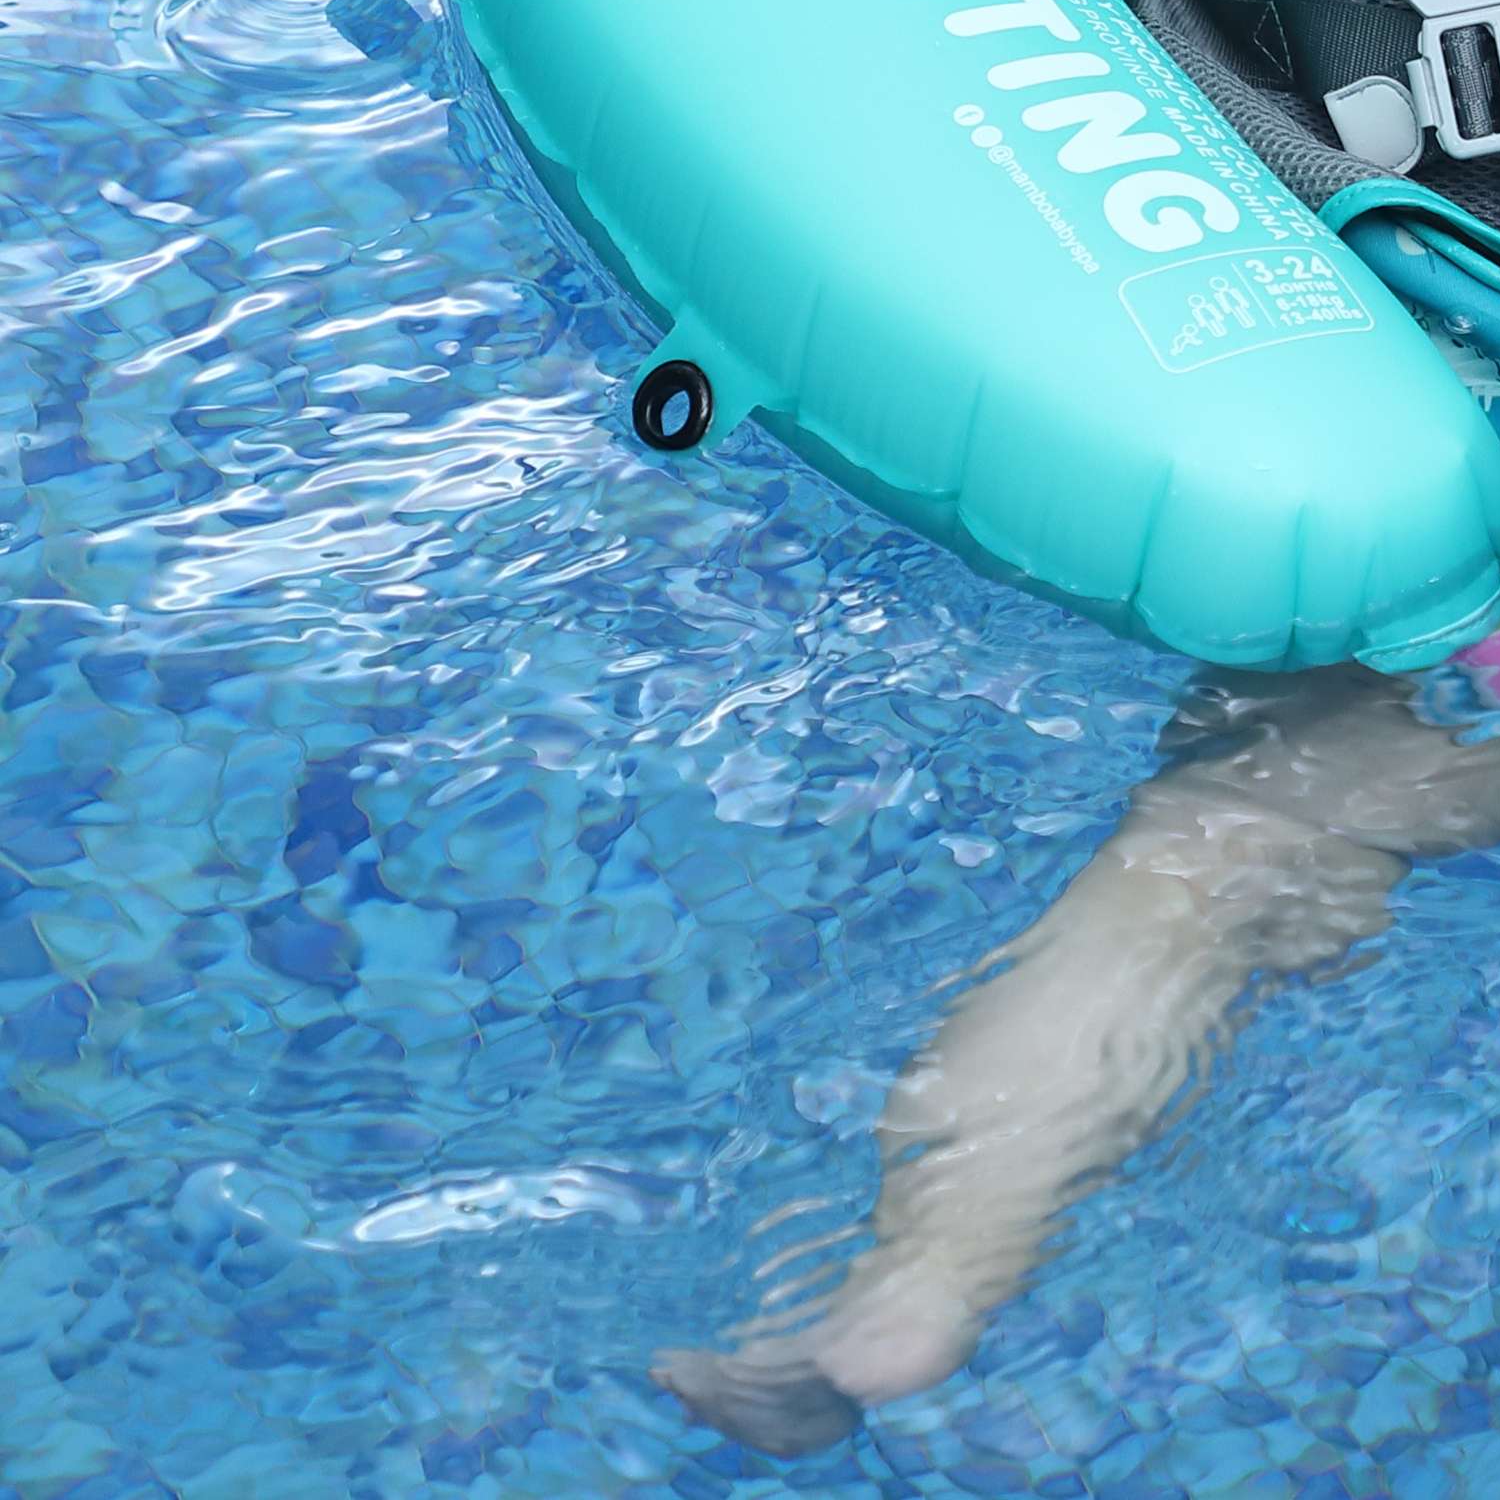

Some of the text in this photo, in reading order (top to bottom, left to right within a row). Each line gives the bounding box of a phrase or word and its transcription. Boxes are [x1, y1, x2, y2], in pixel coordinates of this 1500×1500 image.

[1076, 8, 1168, 98] PROVINCE
[1160, 106, 1219, 158] MADE
[1208, 159, 1238, 180] IN
[1227, 180, 1290, 241] CHINA
[1110, 18, 1226, 138] PRODUCTS
[1265, 196, 1315, 242] LTD.
[988, 145, 1101, 275] @mambobabyspa
[1245, 255, 1332, 286] 3-24
[1265, 280, 1338, 297] MONTHS
